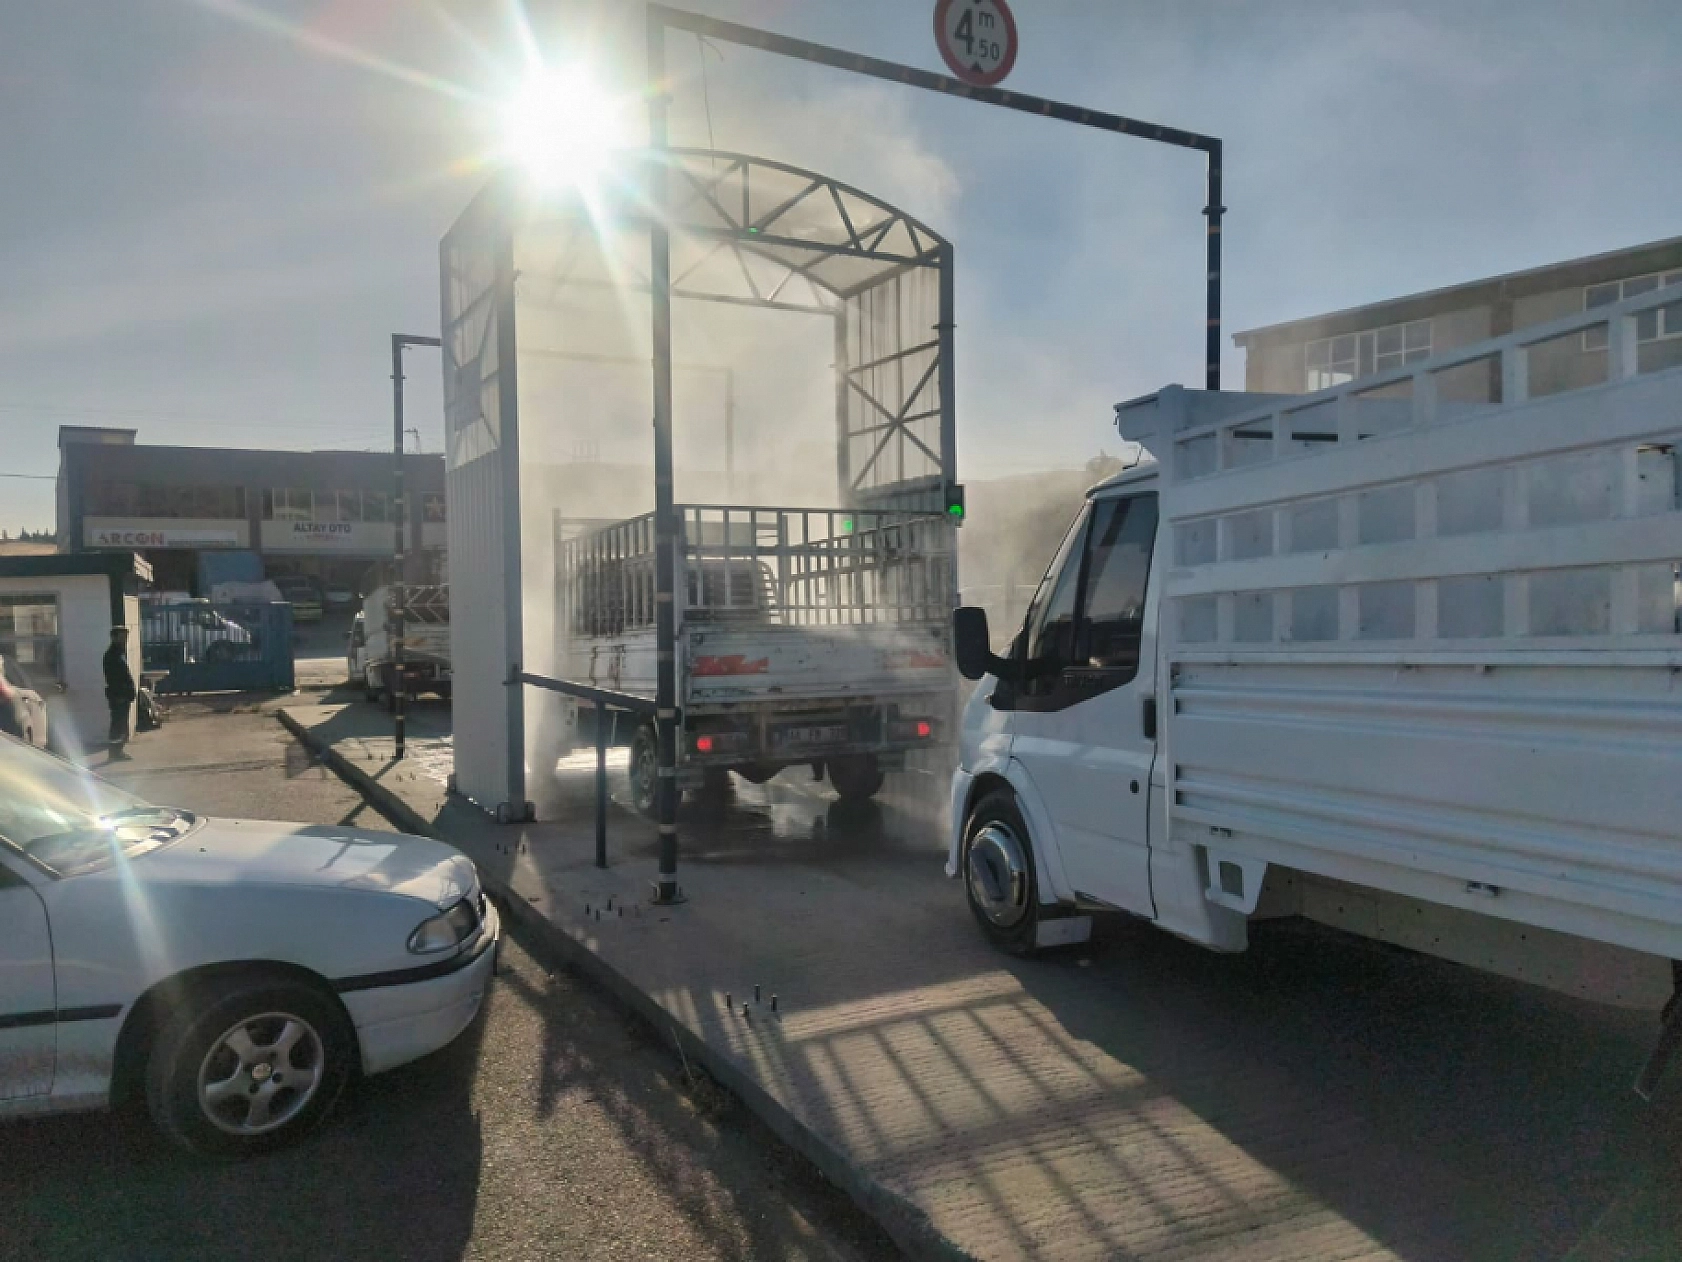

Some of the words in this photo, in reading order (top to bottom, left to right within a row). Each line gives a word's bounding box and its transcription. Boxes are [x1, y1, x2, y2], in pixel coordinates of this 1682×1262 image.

[954, 8, 974, 55] 4
[979, 11, 994, 29] m
[98, 531, 165, 546] ARCON
